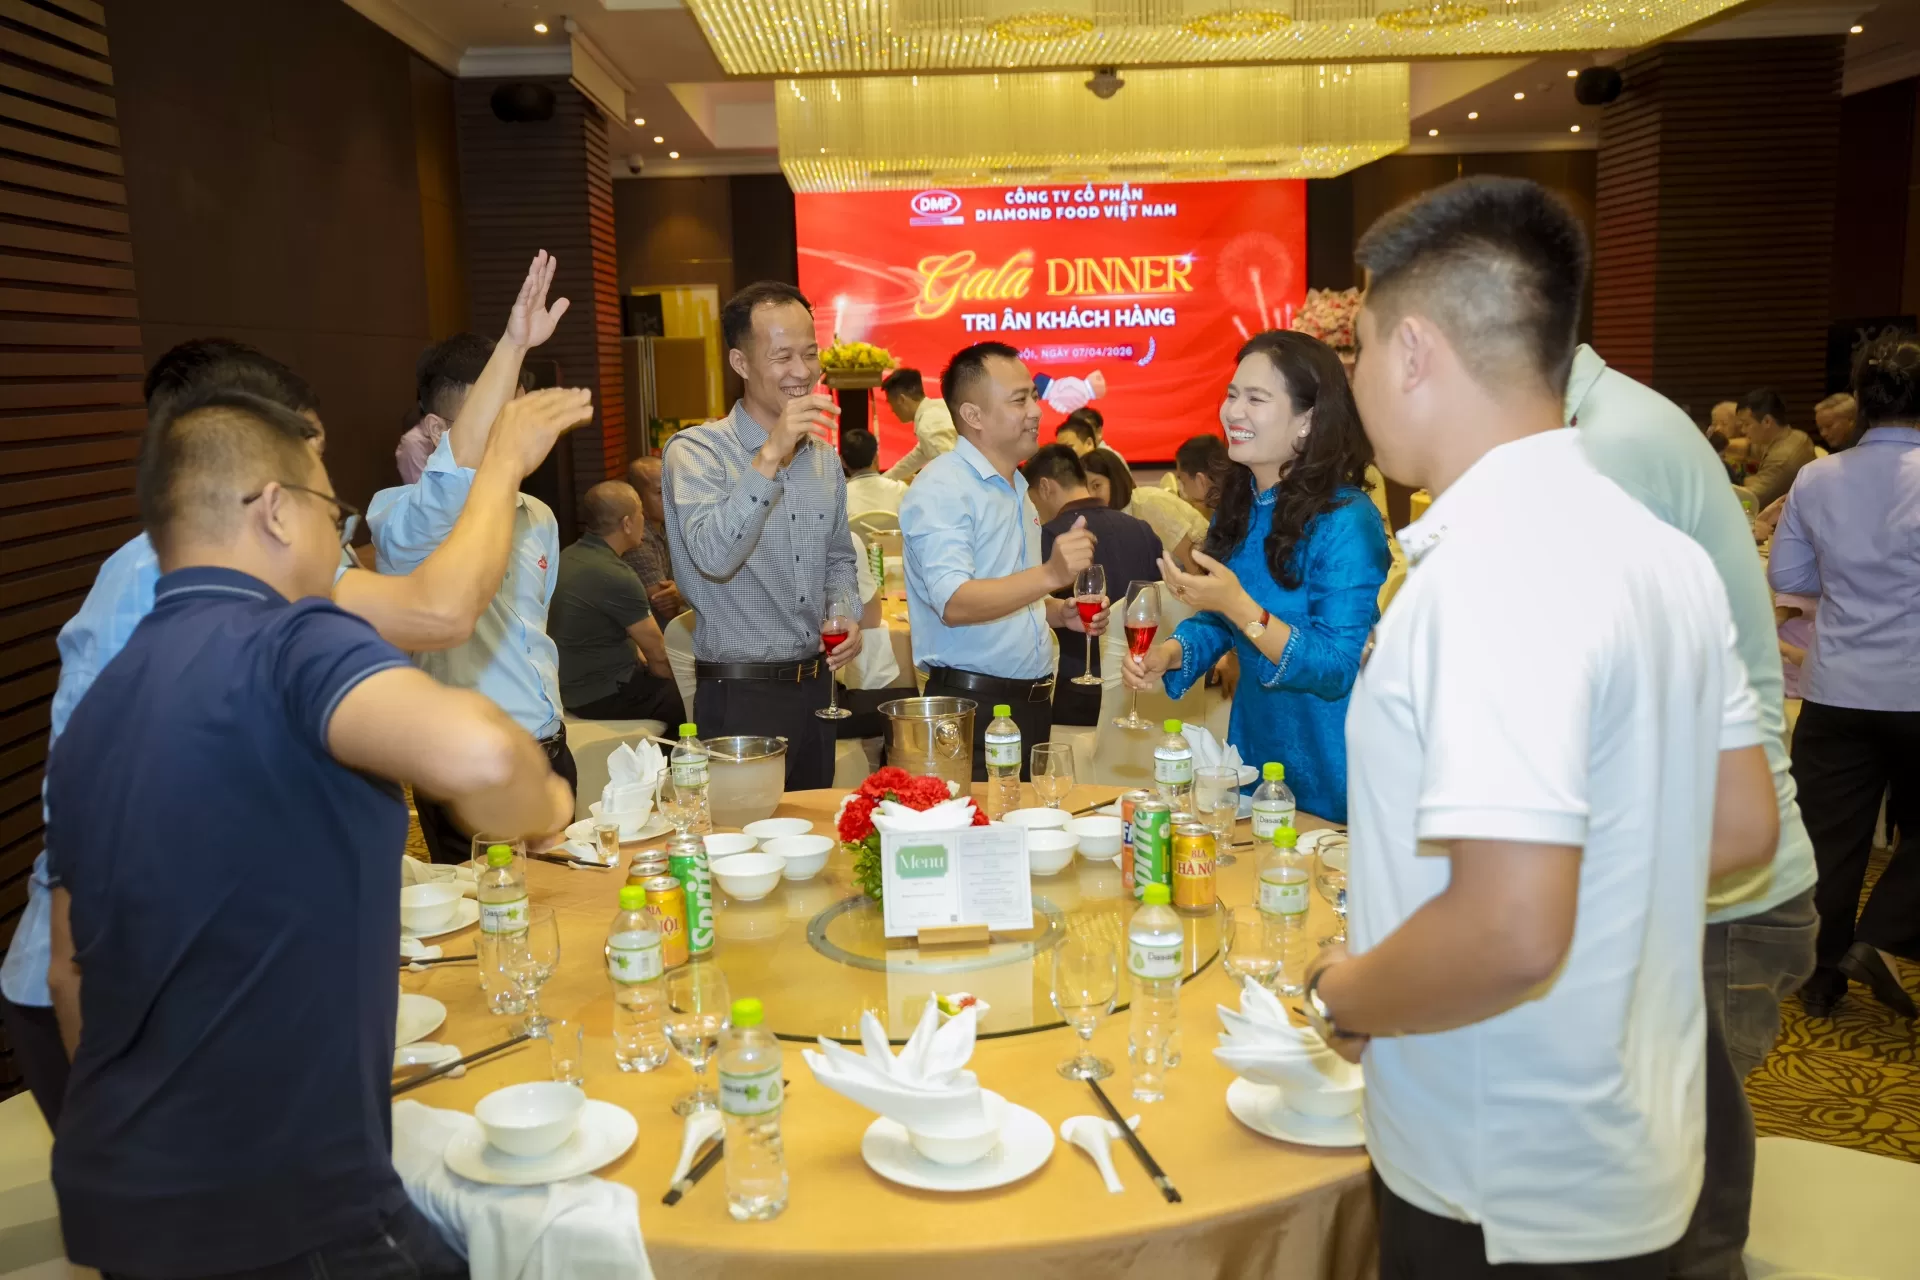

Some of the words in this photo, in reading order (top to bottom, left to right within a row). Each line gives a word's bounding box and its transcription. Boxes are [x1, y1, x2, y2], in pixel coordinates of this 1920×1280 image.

[1004, 186, 1049, 204] CÔNG
[1052, 190, 1070, 203] TY
[919, 196, 953, 212] DMF
[975, 207, 1052, 222] DIAMOND
[1056, 206, 1100, 219] FOOD
[1103, 199, 1138, 221] VIỆT
[1141, 203, 1177, 217] NAM
[914, 250, 1034, 319] Gala
[1046, 254, 1193, 296] DINNER
[962, 314, 996, 332] TRI
[1000, 307, 1031, 330] ÂN
[1036, 305, 1110, 329] KHÁCH
[1115, 304, 1176, 327] HÀNG
[1072, 345, 1133, 358] 07/04/2026
[900, 854, 944, 869] Menu
[1191, 849, 1207, 859] BIA
[1177, 861, 1195, 875] HÀ
[685, 852, 714, 947] Sprite
